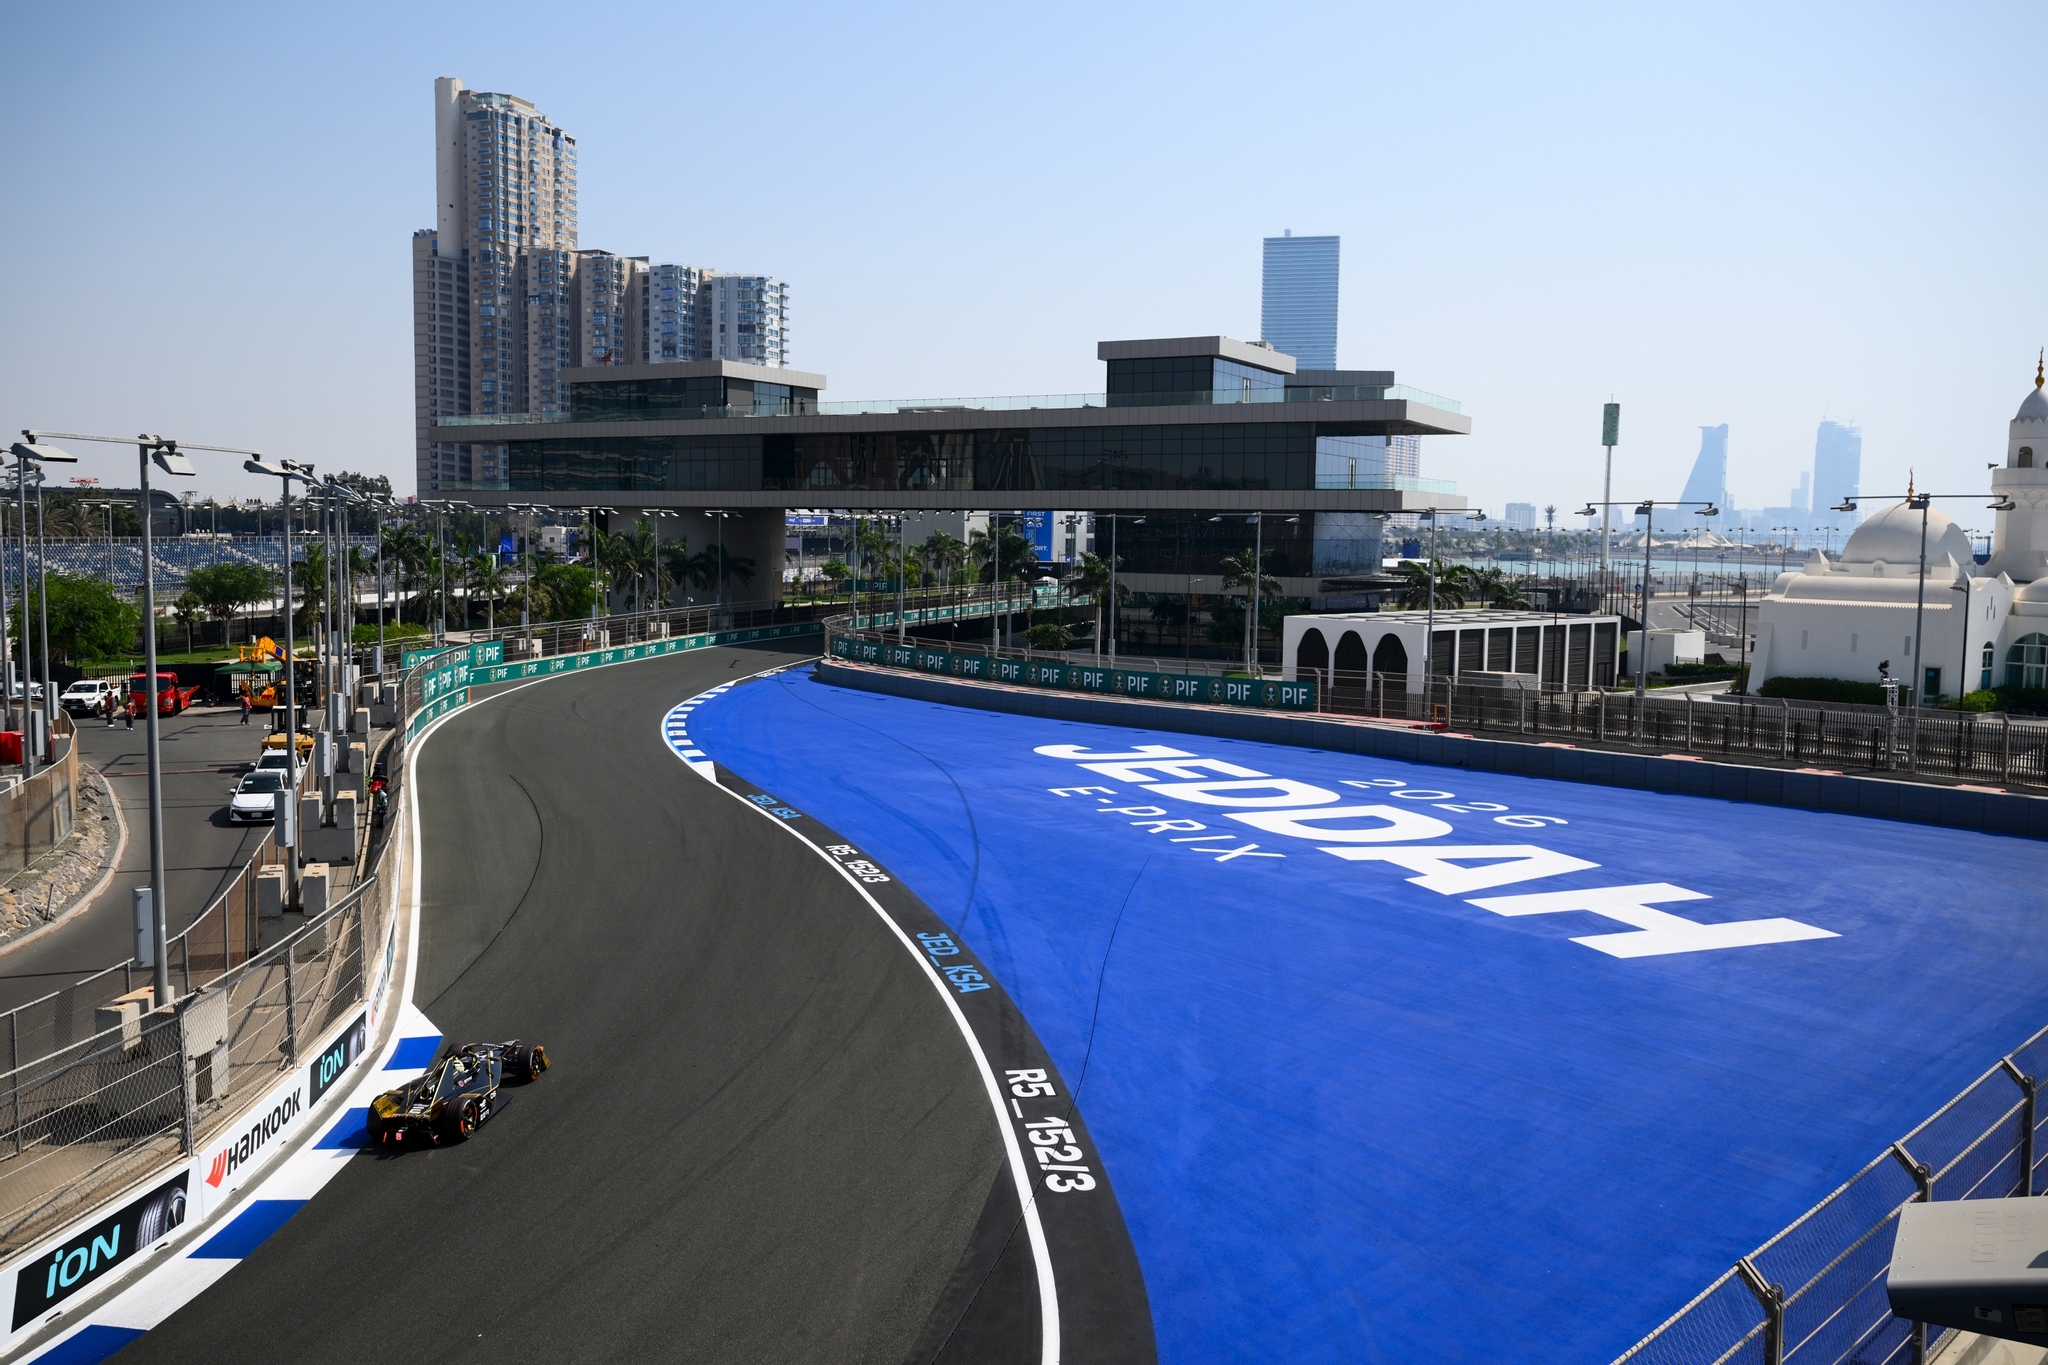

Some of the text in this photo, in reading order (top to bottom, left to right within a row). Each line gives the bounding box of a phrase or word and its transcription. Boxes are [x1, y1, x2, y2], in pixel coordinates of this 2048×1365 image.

[428, 677, 436, 697] PIF
[442, 671, 452, 688] PIF
[459, 665, 468, 682] PIF
[486, 646, 499, 661] PIF
[497, 668, 507, 679] PIF
[528, 664, 537, 674] PIF
[555, 660, 565, 670] PIF
[581, 656, 590, 666] PIF
[605, 652, 614, 661] PIF
[627, 649, 635, 658] PIF
[730, 633, 738, 641] PIF
[838, 641, 1308, 705] PIF PIF PIF PIF PIF PIF PIF PIF PIF PIF PIF PIF
[746, 793, 802, 820] JED_KSA
[1048, 785, 1286, 863] E-PRIX
[1338, 778, 1568, 829] 2026
[825, 843, 890, 884] R5_152/3
[1033, 744, 1843, 959] JEDDAH
[916, 931, 991, 995] JED_KSA
[1004, 1067, 1097, 1194] R5_152/3
[46, 1223, 121, 1299] iON
